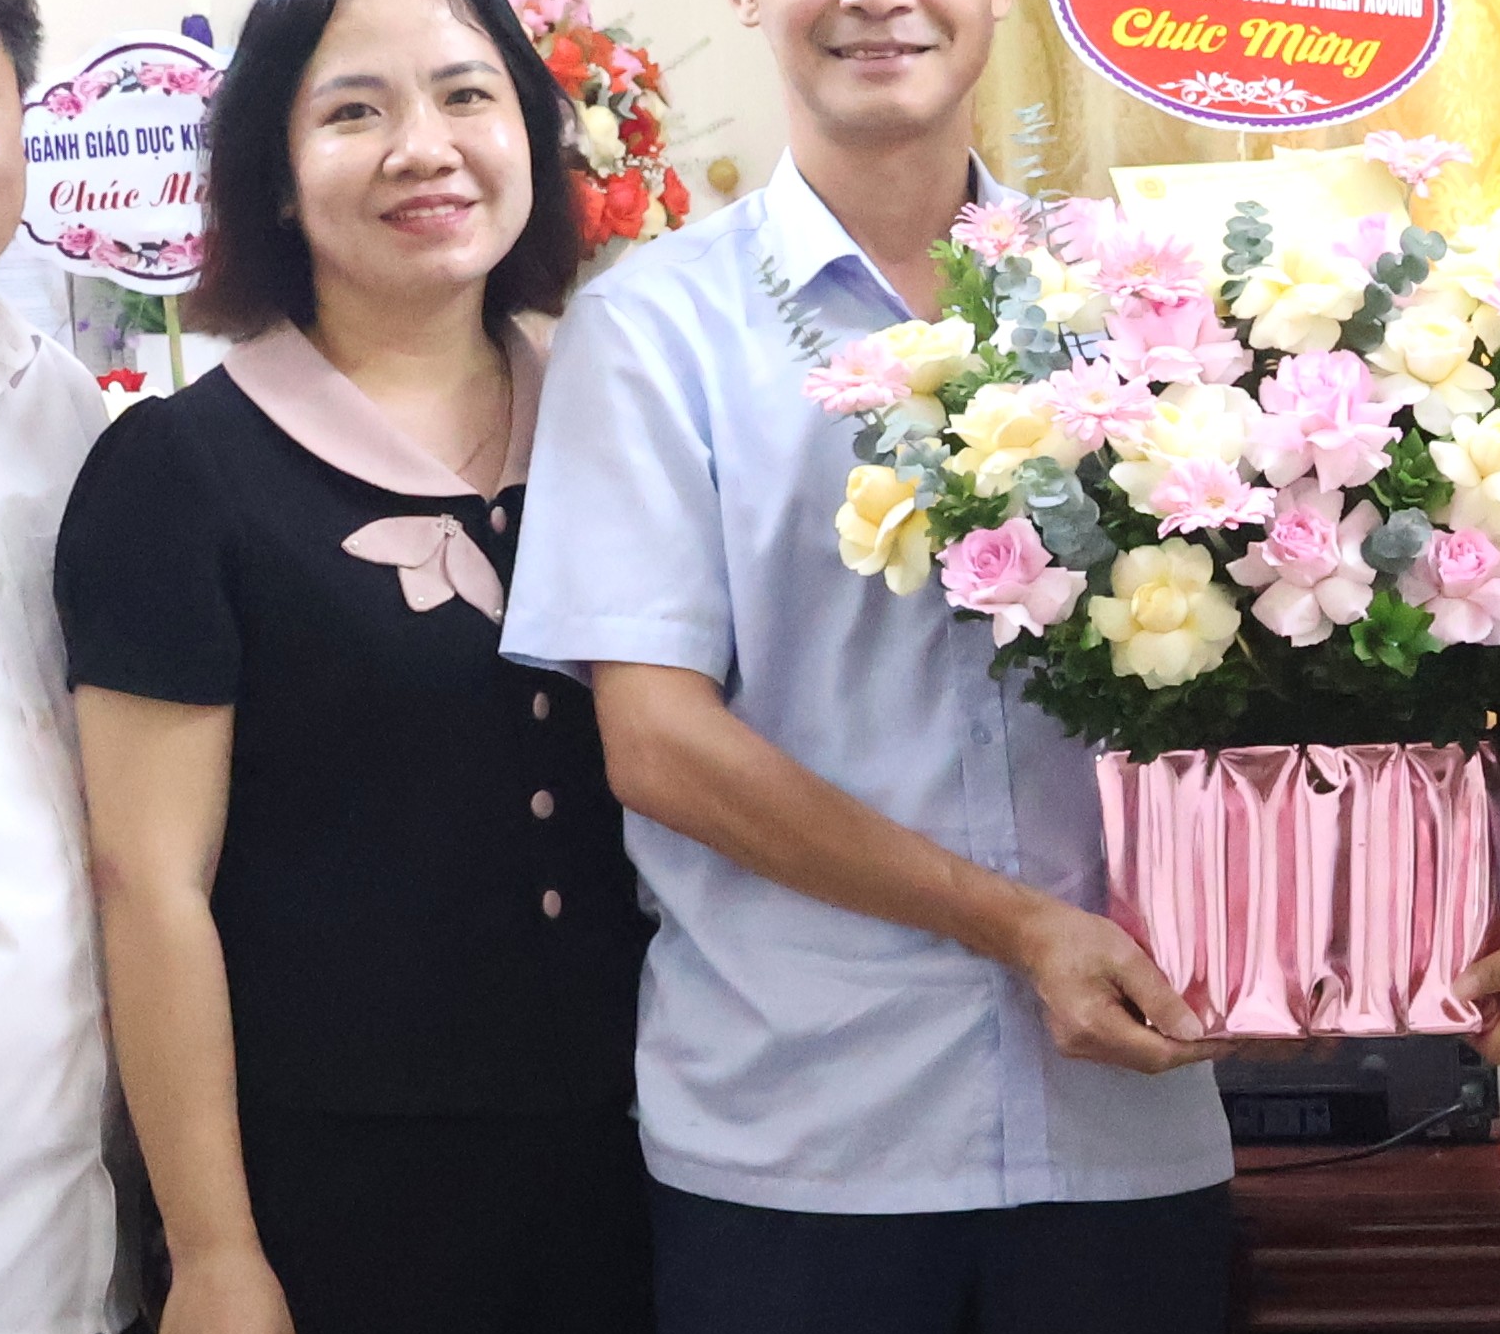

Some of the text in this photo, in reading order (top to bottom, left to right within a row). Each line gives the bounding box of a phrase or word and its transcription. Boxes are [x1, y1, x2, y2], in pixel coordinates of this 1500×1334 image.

[1111, 7, 1381, 78] Chúc Mừng
[85, 123, 130, 158] GIÁO
[136, 126, 175, 160] DỤC
[49, 179, 142, 215] Chúc
